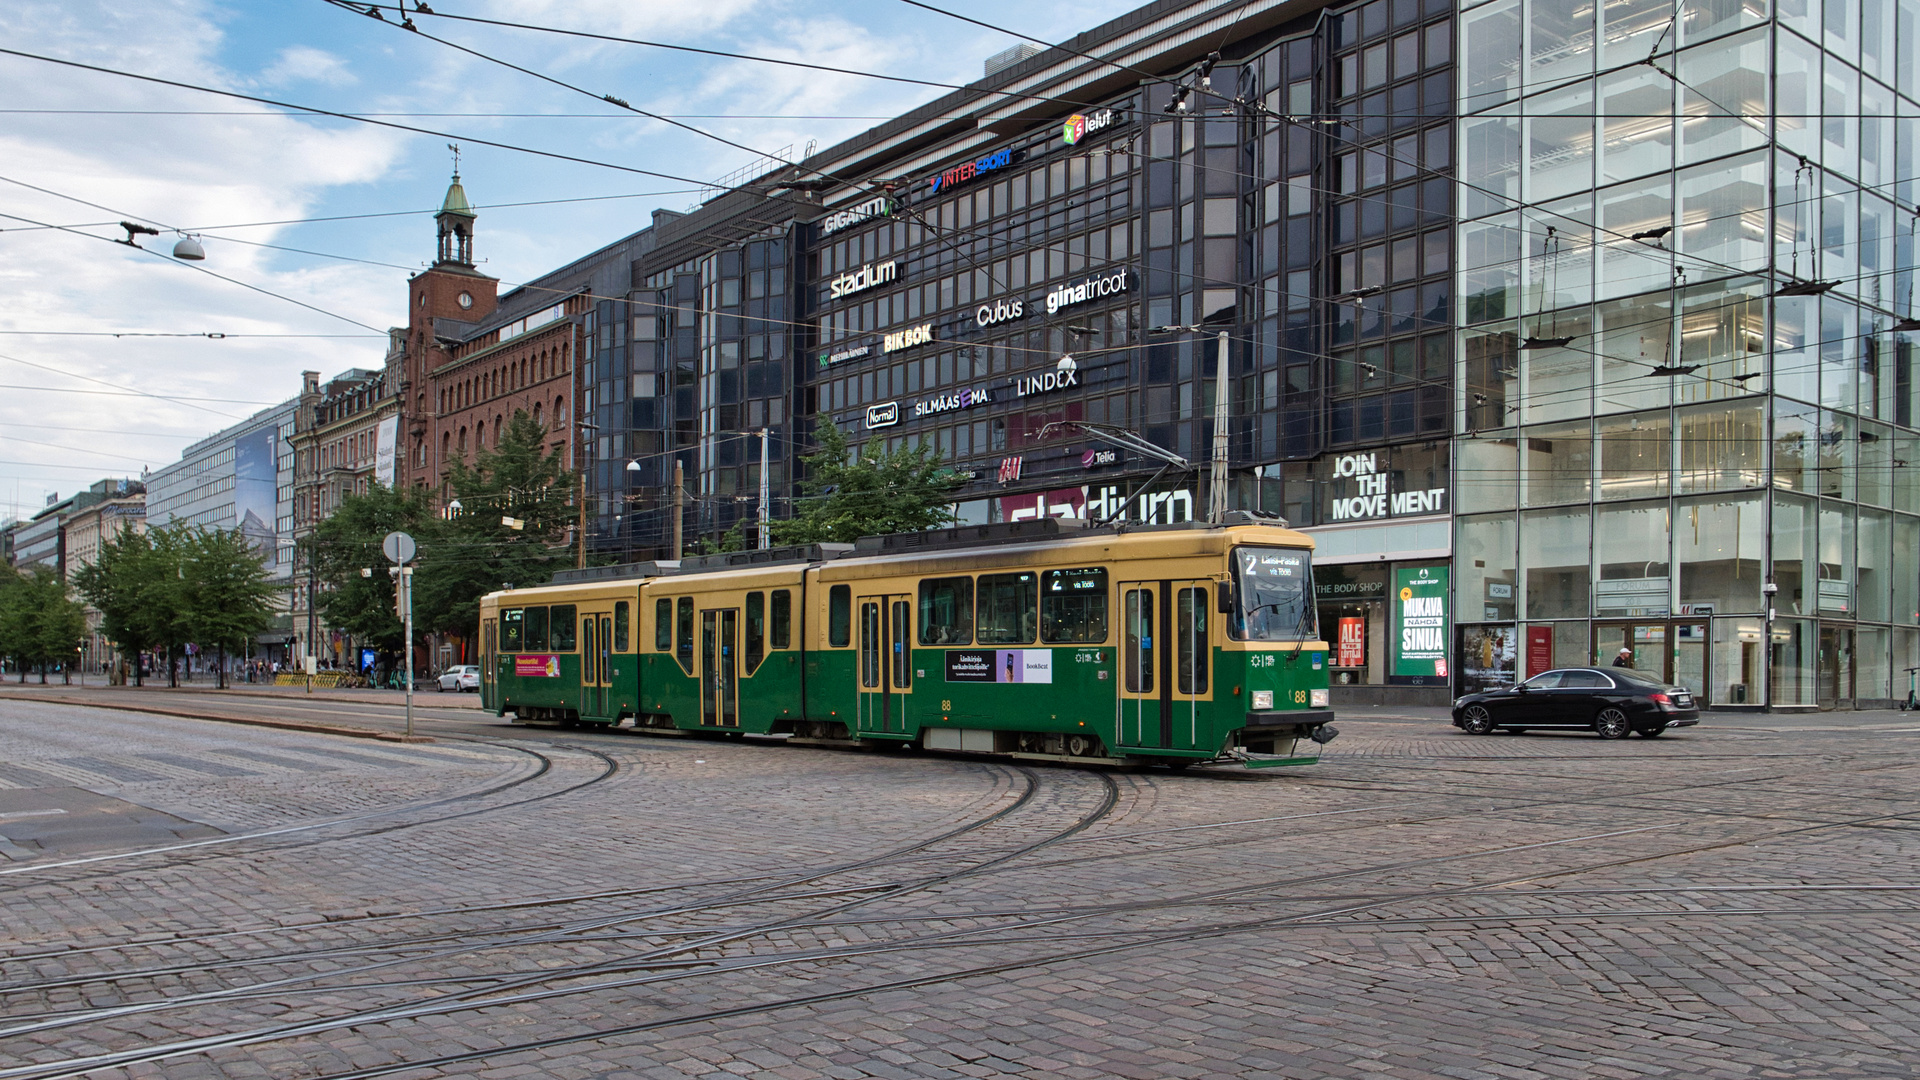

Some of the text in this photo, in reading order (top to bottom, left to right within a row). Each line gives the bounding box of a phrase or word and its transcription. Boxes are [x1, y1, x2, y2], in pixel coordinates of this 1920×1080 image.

[942, 149, 1012, 188] INTERSPORT
[825, 197, 886, 233] GIGANTTI
[830, 260, 896, 299] stadium
[976, 300, 1023, 327] Cubus
[1017, 369, 1077, 396] LINDEX
[869, 408, 895, 424] Normal
[1095, 451, 1116, 464] Telia
[1332, 453, 1376, 478] JOIN
[1245, 554, 1257, 576] 2
[1316, 581, 1383, 594] THE BODY SHOP
[1403, 597, 1443, 618] MUKAVA
[1341, 623, 1362, 643] ALE
[1402, 627, 1444, 651] SINUA
[941, 699, 951, 711] 88
[1294, 690, 1306, 704] 88
